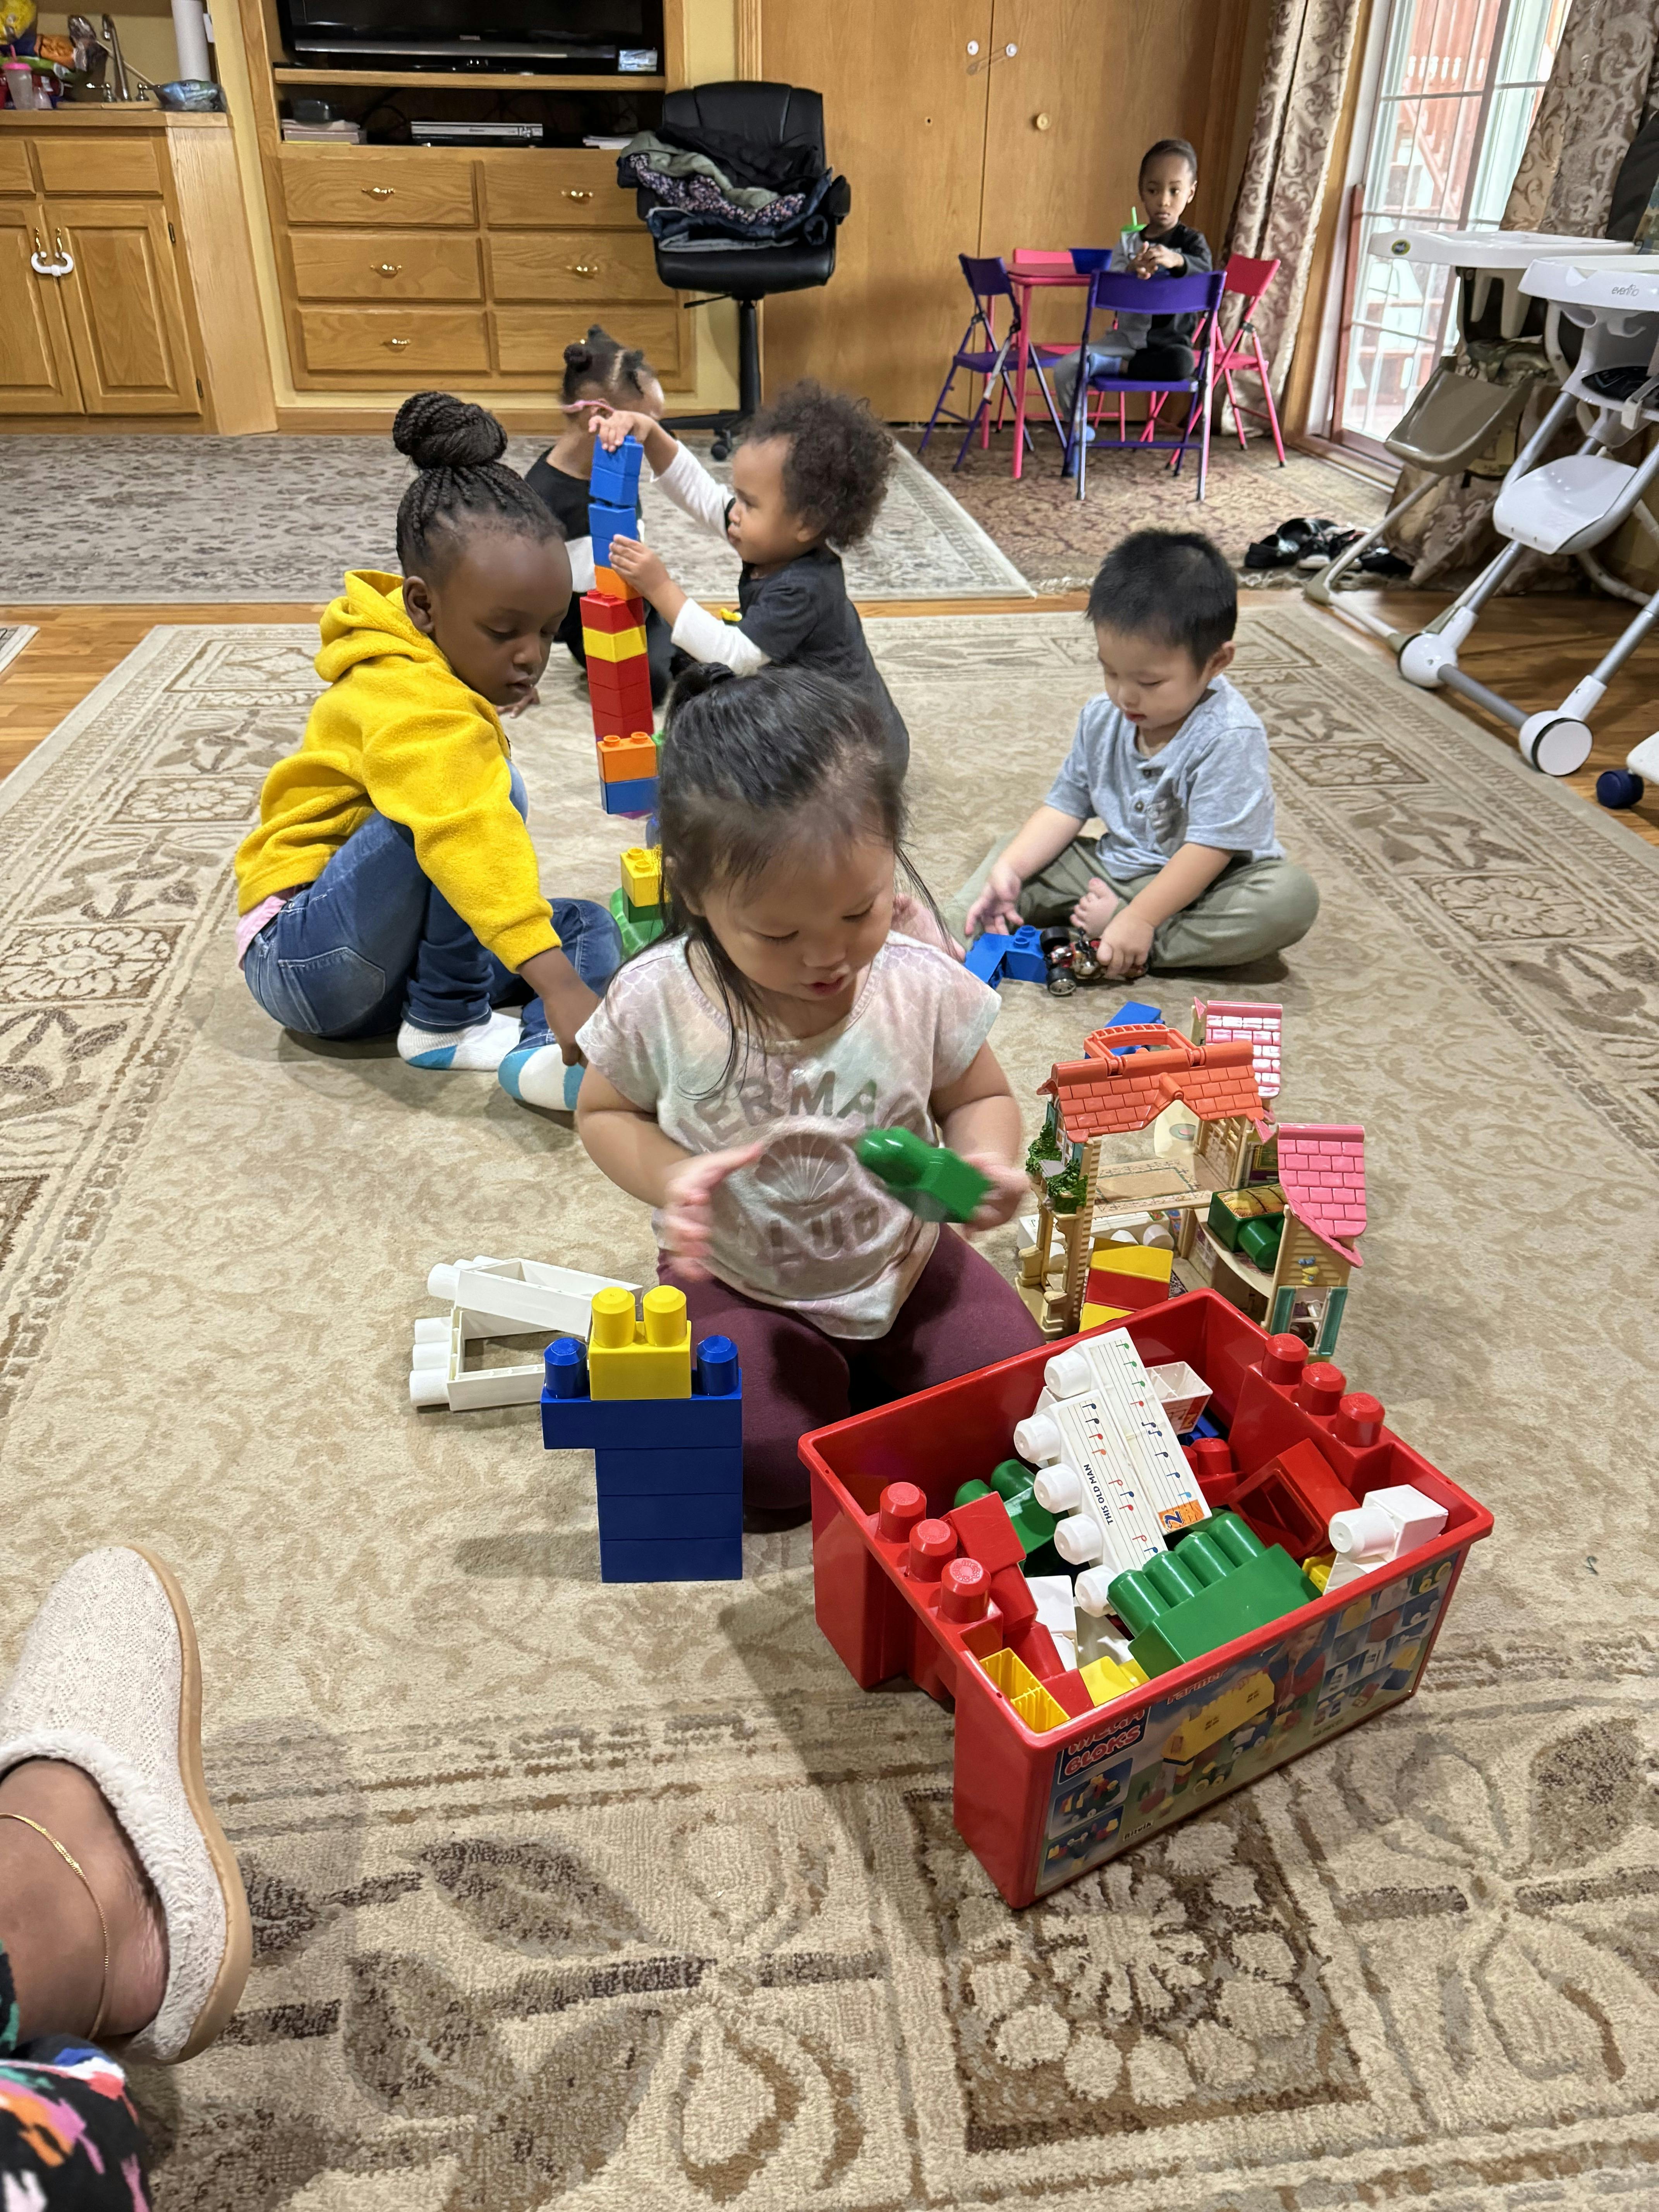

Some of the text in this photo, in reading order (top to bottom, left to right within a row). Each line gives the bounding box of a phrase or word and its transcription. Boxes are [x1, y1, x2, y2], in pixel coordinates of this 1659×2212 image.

[1084, 1463, 1114, 1525] THIS OLD MAN
[1064, 1725, 1141, 1776] BLOKS
